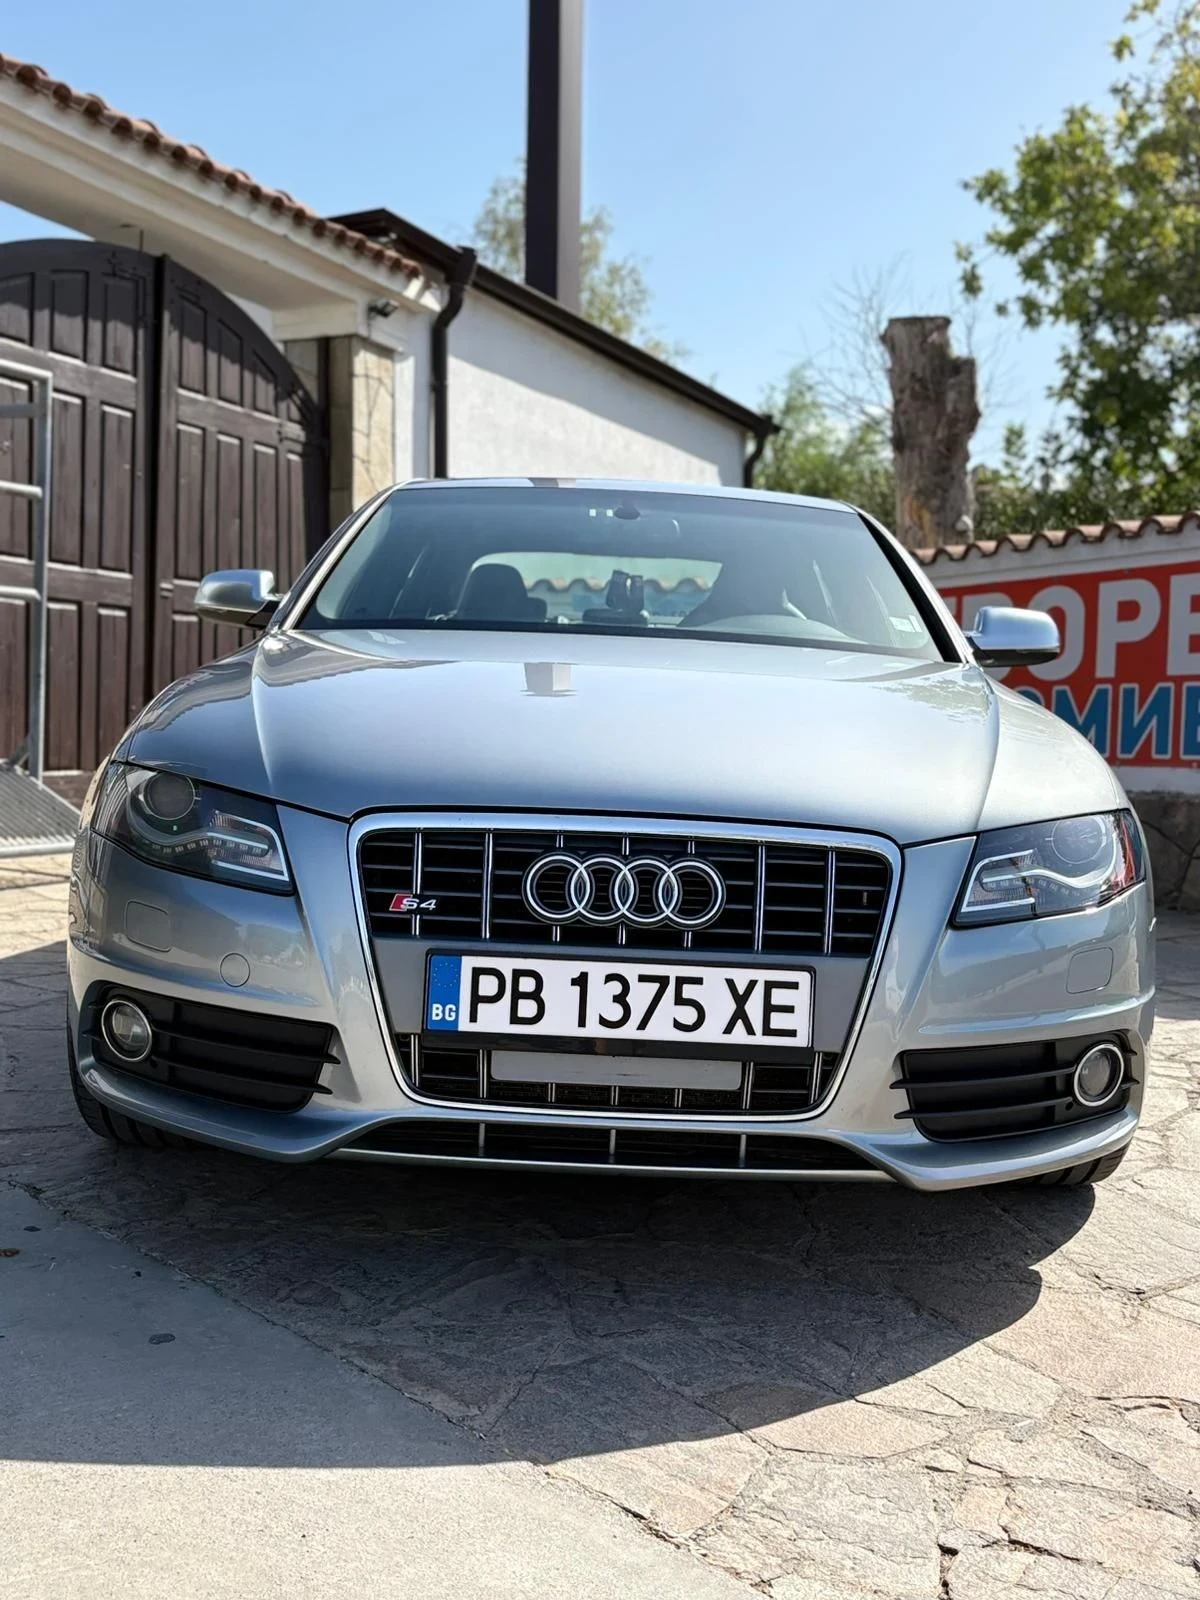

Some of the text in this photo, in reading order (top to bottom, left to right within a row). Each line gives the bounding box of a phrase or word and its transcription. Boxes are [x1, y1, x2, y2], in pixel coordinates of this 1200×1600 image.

[401, 898, 437, 910] S4
[469, 967, 800, 1038] PB 1375 XE
[431, 1003, 457, 1021] BG
